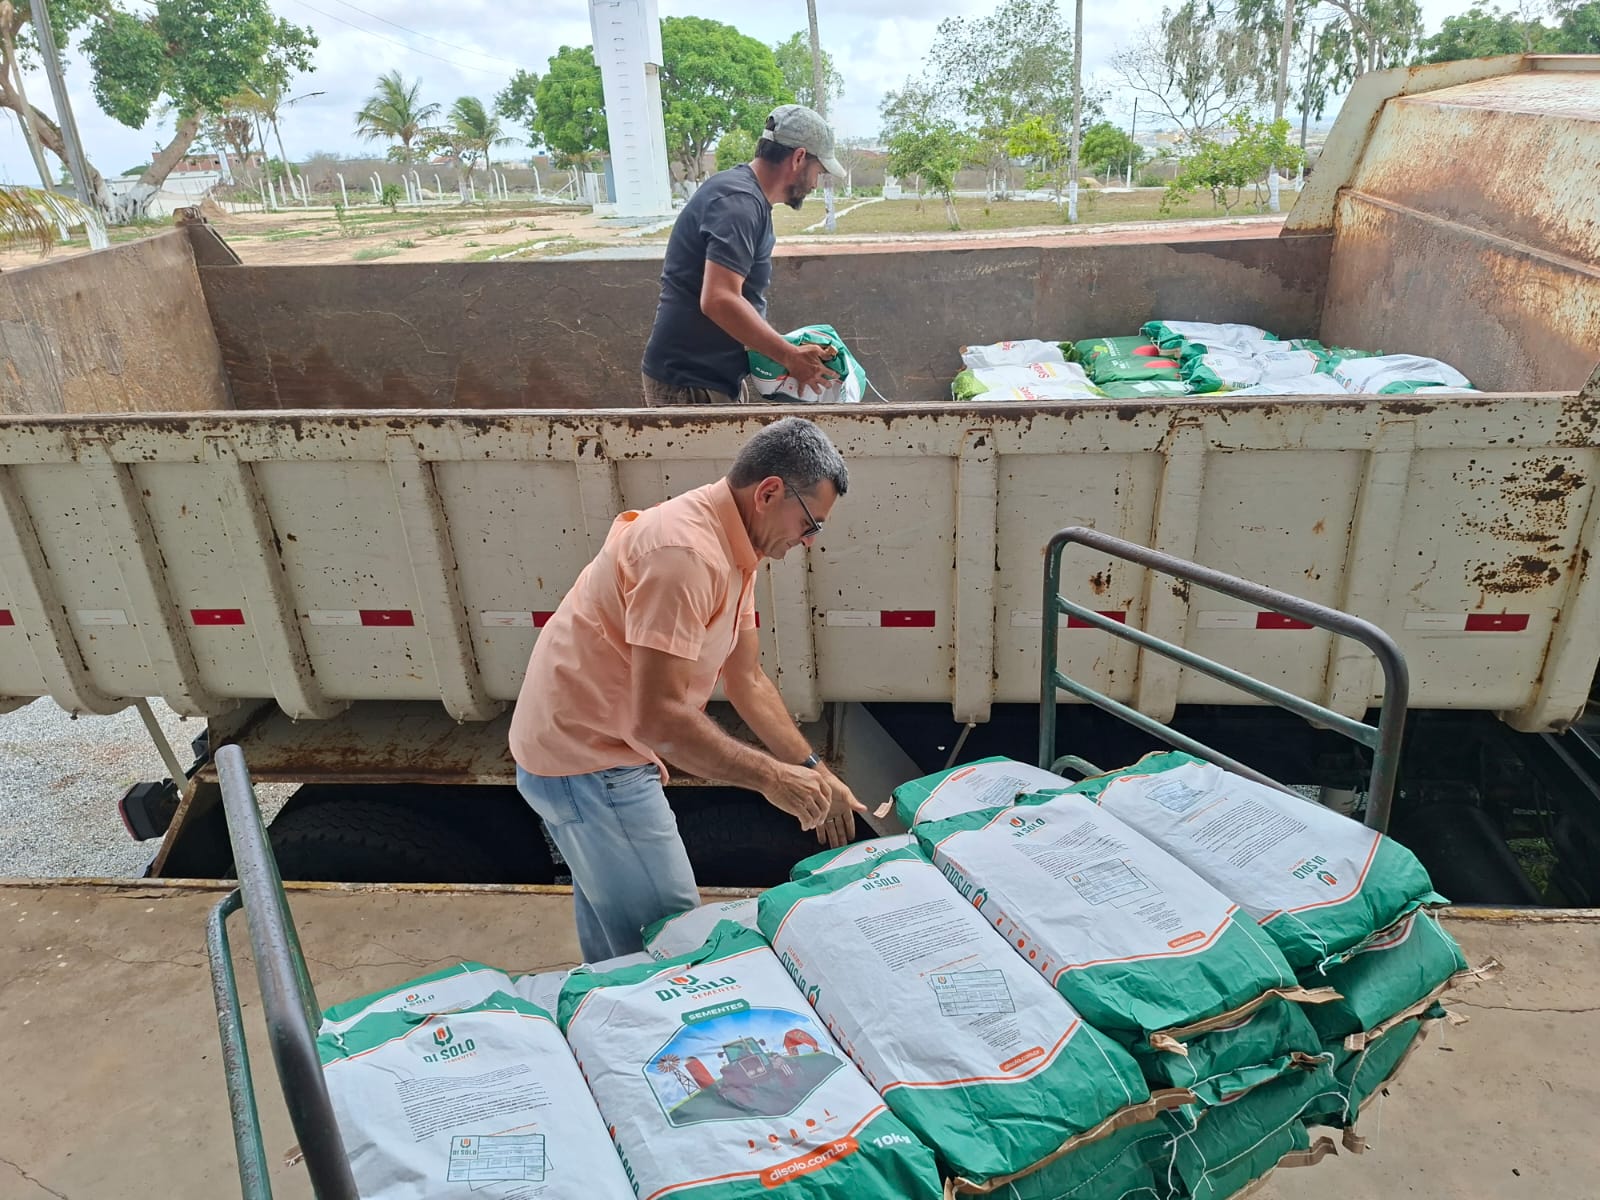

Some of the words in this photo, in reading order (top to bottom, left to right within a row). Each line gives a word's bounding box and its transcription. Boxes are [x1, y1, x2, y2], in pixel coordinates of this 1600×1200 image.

[1022, 818, 1046, 834] SOLO
[1311, 855, 1328, 866] DI
[942, 862, 964, 891] SOLO
[1292, 861, 1319, 880] SOLO
[862, 881, 875, 891] DI
[874, 875, 901, 888] SOLO
[961, 880, 973, 897] DI
[655, 988, 682, 1002] DI
[682, 976, 737, 994] SOLO
[691, 984, 743, 1000] SEMENTES
[688, 1002, 744, 1021] SEMENTES
[423, 1053, 439, 1063] DI
[440, 1038, 476, 1060] SOLO
[769, 1141, 849, 1182] disolo.com.br
